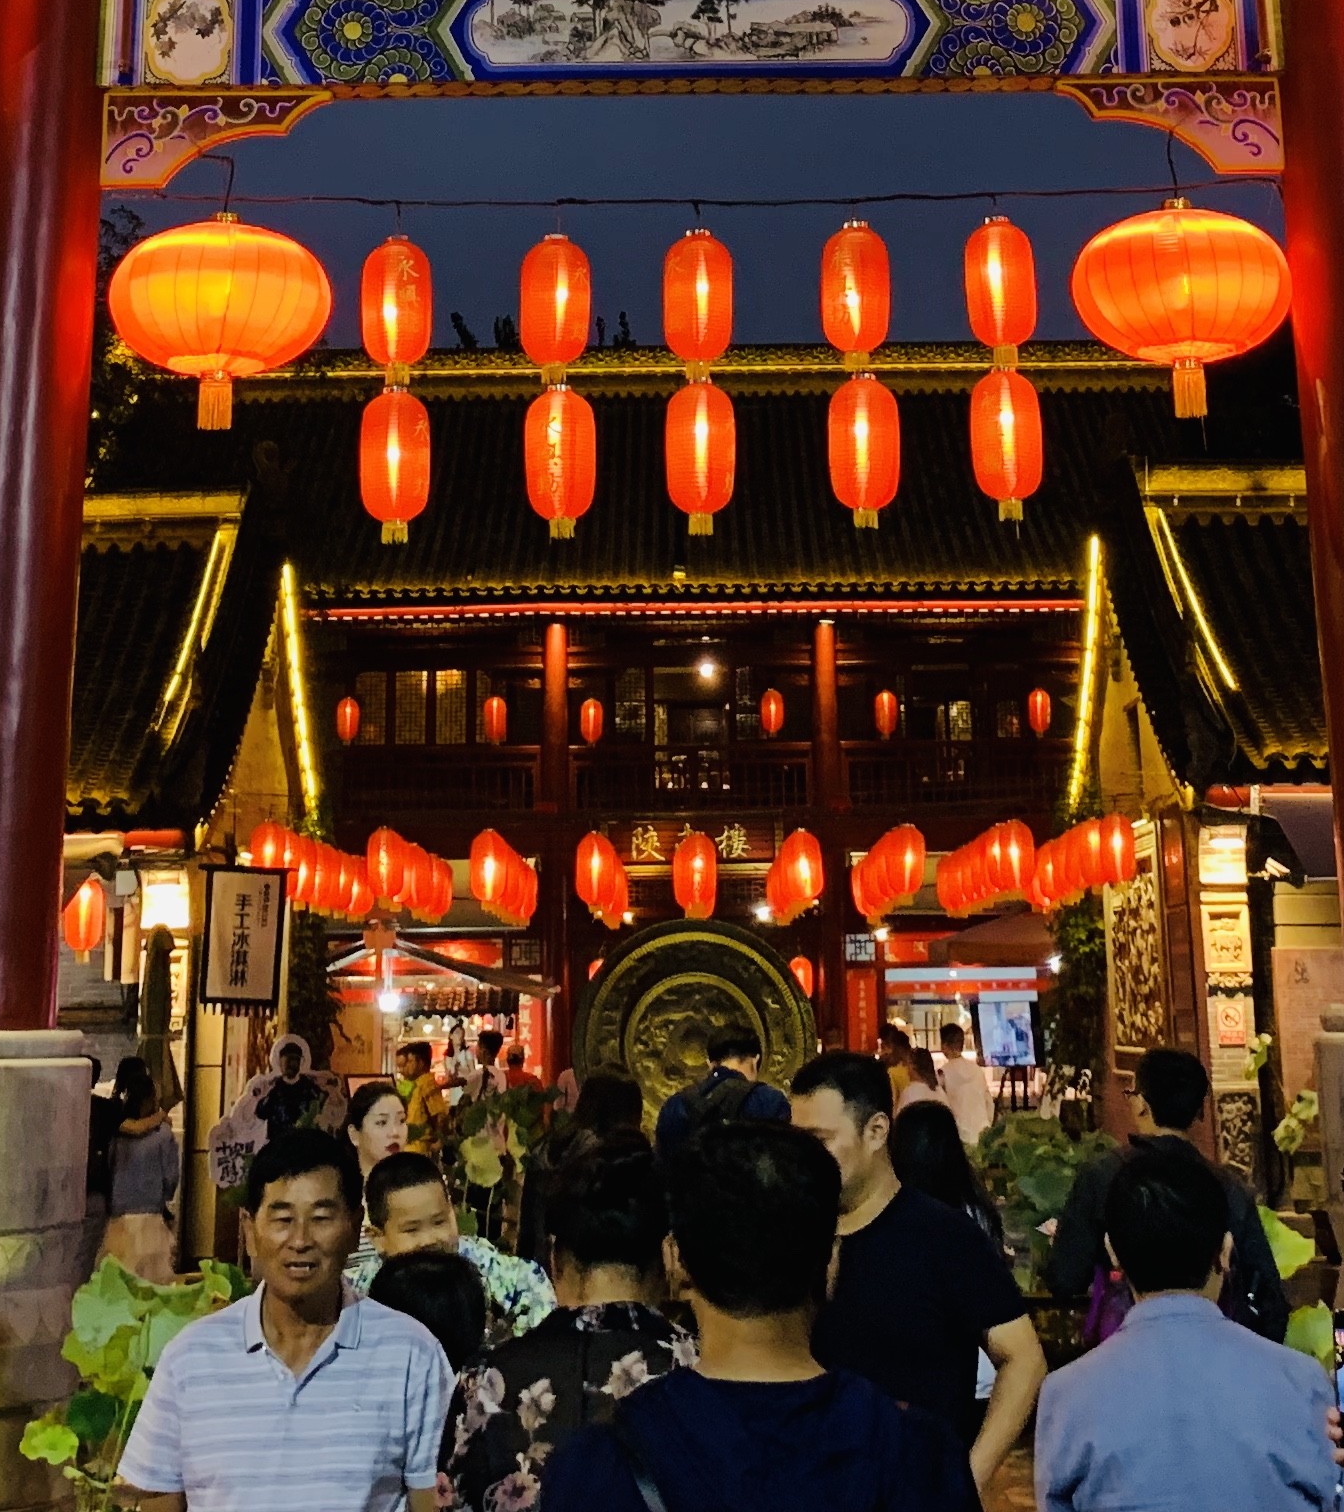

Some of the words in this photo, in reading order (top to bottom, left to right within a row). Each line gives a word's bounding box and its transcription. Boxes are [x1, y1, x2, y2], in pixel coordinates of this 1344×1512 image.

[229, 893, 254, 987] 手工冰淇淋
